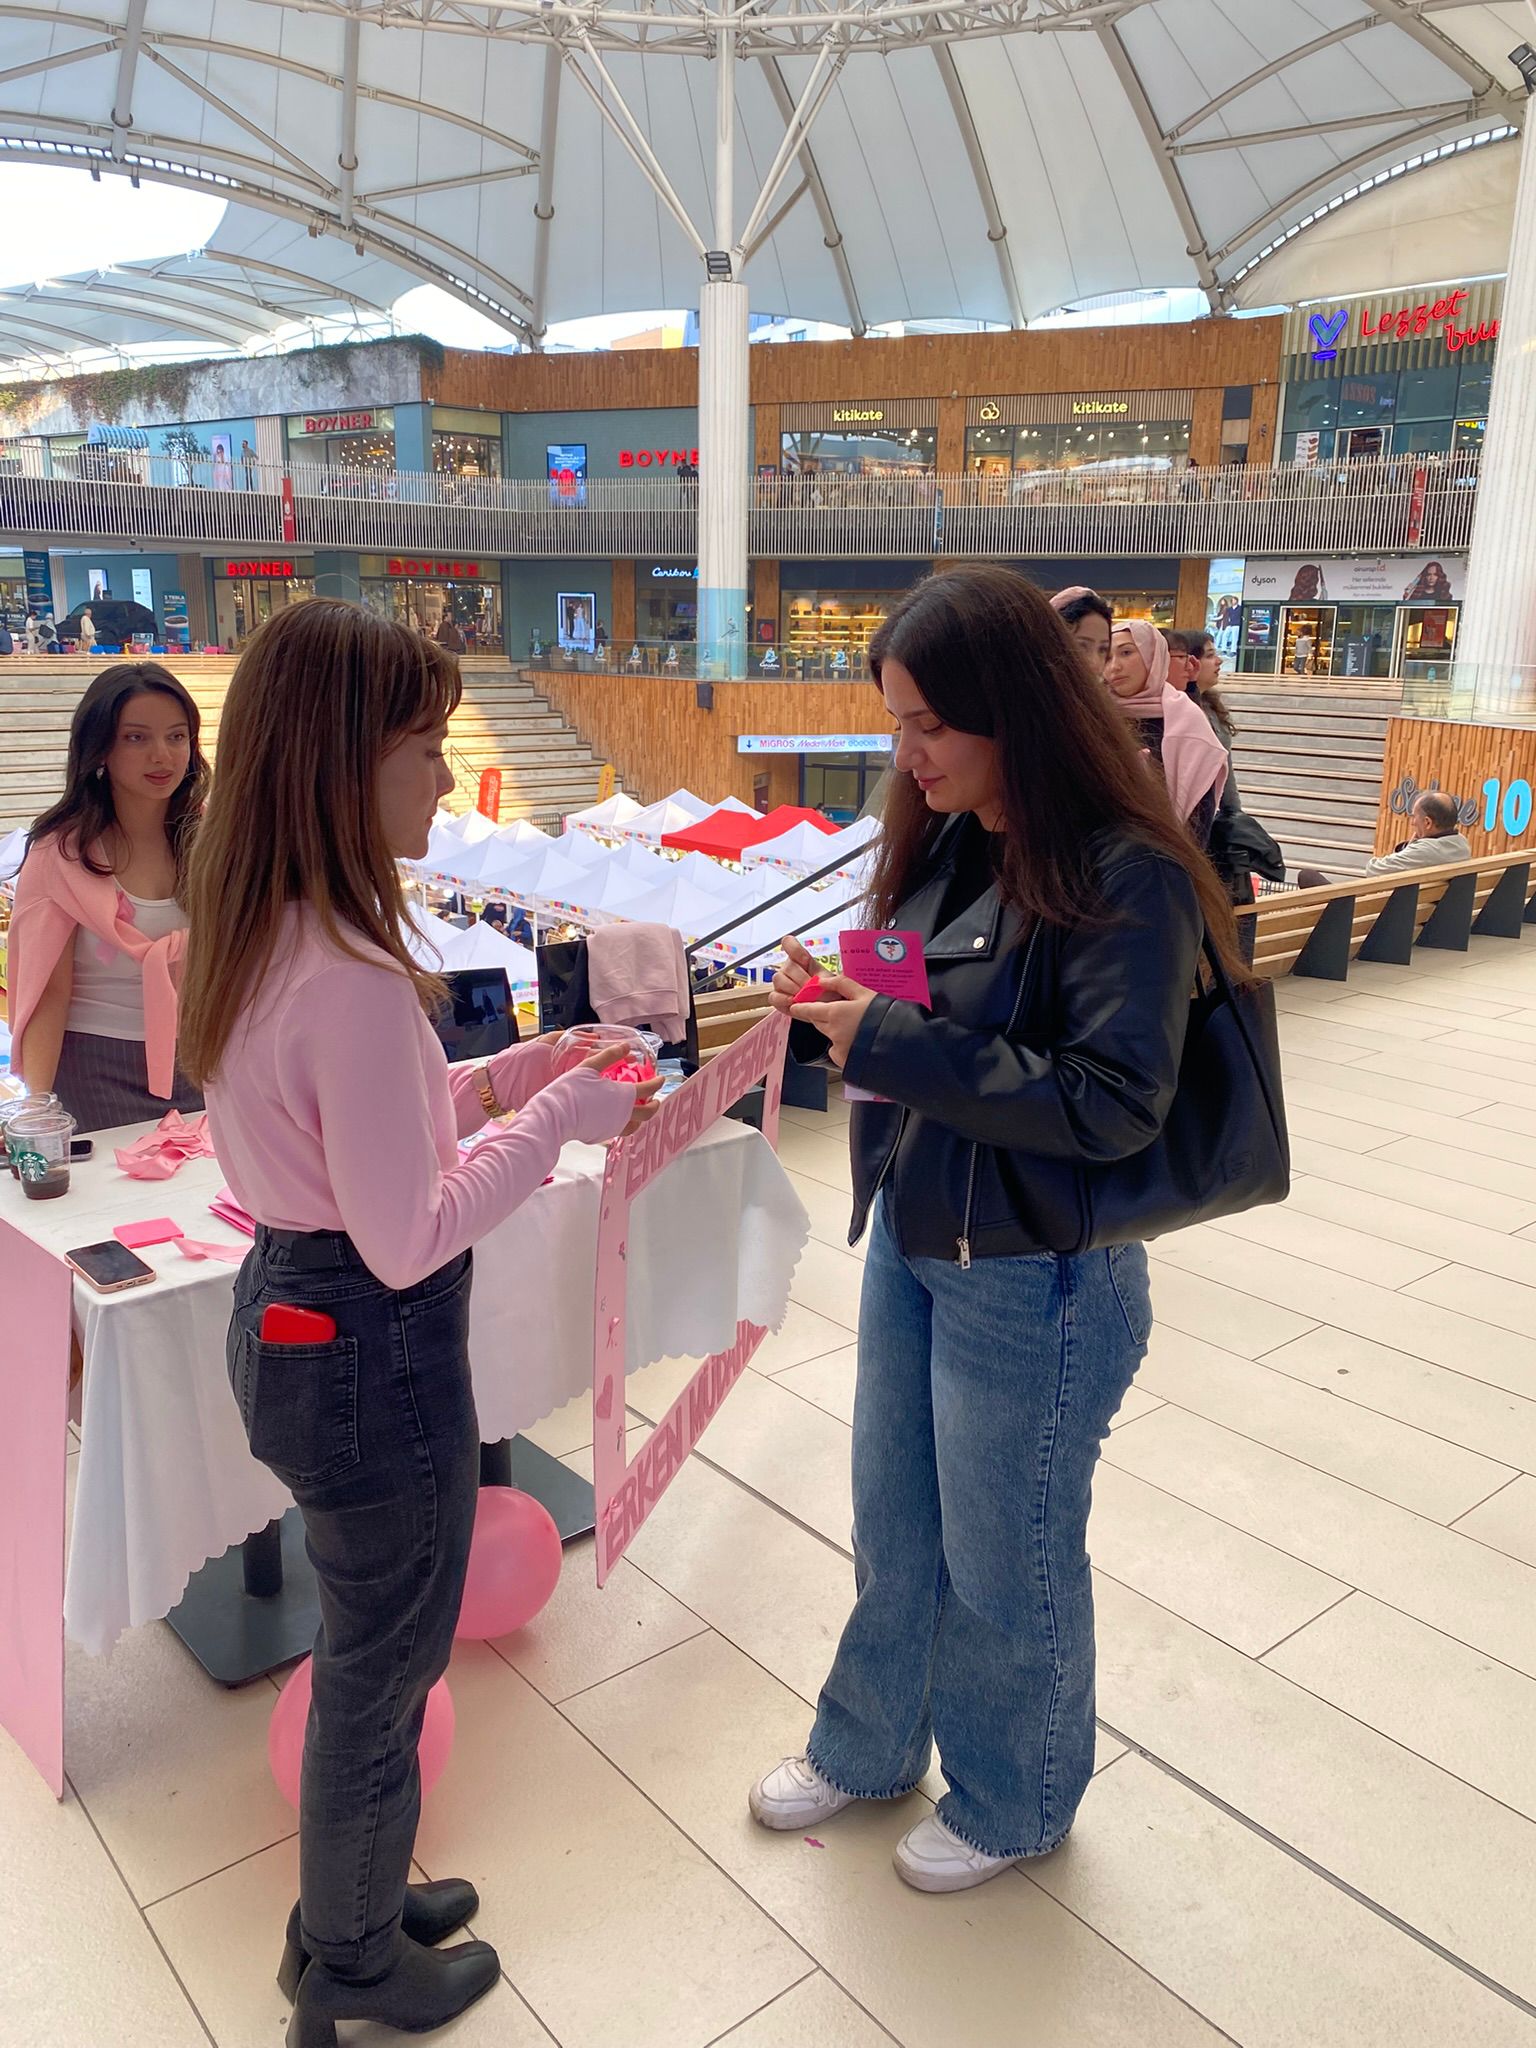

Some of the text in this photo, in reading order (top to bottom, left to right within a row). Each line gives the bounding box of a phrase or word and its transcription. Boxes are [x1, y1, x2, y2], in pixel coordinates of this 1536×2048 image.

[1361, 289, 1469, 338] Lezzet
[833, 409, 884, 423] kitikate
[1072, 401, 1129, 415] kitikate
[305, 413, 372, 433] BOYNER
[618, 447, 699, 468] BOYNE
[227, 560, 293, 577] BOYNER
[388, 559, 479, 577] BOYNER
[651, 566, 692, 577] Caribou
[1251, 575, 1277, 586] dyson
[1482, 777, 1532, 837] 10
[624, 1072, 709, 1201] ERKEN
[605, 1404, 683, 1571] ERKEN
